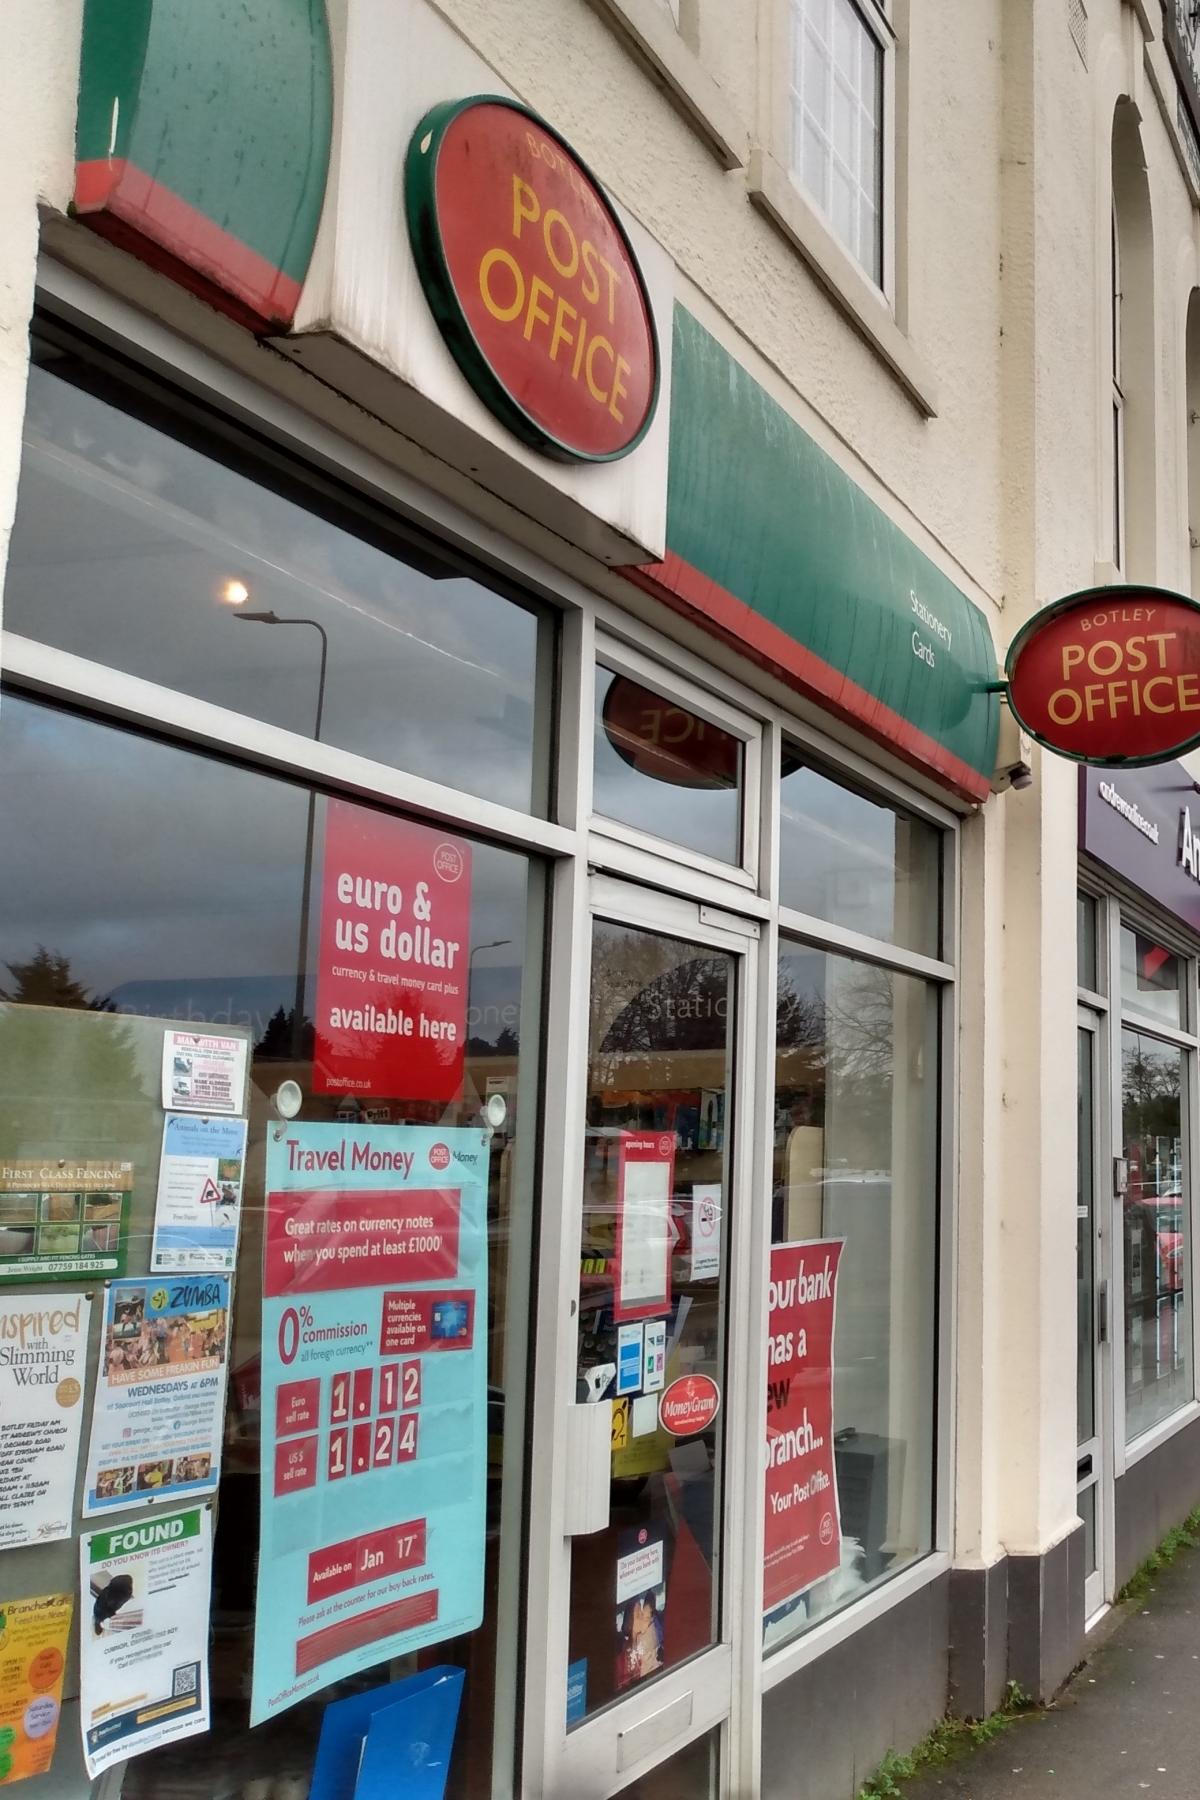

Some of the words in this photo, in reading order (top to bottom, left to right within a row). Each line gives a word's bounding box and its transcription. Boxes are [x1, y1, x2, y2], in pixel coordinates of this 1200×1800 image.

[512, 173, 622, 325] POST
[479, 248, 631, 425] OFFICE
[910, 590, 952, 651] Stationery
[1080, 608, 1156, 631] BOTLEY
[912, 631, 935, 668] Cards
[1062, 633, 1176, 681] POST
[1048, 674, 1200, 725] OFFICE
[437, 861, 459, 874] OFFICE
[441, 851, 457, 863] POST
[337, 873, 402, 915] euro
[413, 881, 432, 922] &
[335, 918, 369, 954] us
[380, 920, 459, 969] dollar
[332, 965, 367, 982] currency
[369, 969, 376, 982] &
[377, 970, 399, 986] travel
[401, 977, 425, 991] money
[427, 980, 442, 992] card
[444, 981, 459, 995] plus
[330, 1004, 413, 1037] available
[420, 1012, 457, 1041] here
[326, 1077, 371, 1090] postoffice.co.uk
[432, 1148, 448, 1157] POST
[625, 1141, 642, 1150] opening
[643, 1141, 655, 1149] hours
[286, 1139, 346, 1172] Travel
[352, 1139, 414, 1180] Money
[430, 1155, 449, 1164] OFFICE
[453, 1150, 478, 1165] Money
[2, 1168, 33, 1179] FIRST
[40, 1168, 73, 1179] CLASS
[76, 1168, 121, 1179] FENCING
[285, 1217, 315, 1235] Great
[317, 1219, 341, 1233] rates
[343, 1221, 357, 1231] on
[359, 1216, 403, 1234] currency
[406, 1215, 433, 1229] notes
[284, 1244, 315, 1263] when
[315, 1247, 336, 1266] you
[338, 1240, 369, 1263] spend
[371, 1243, 381, 1257] at
[383, 1238, 406, 1255] least
[48, 1262, 72, 1270] 07759
[768, 1277, 796, 1312] our
[798, 1255, 833, 1305] bank
[171, 1283, 220, 1308] ZUMBA
[388, 1299, 416, 1313] Multiple
[387, 1313, 422, 1323] currencies
[302, 1321, 368, 1343] commission
[386, 1323, 416, 1336] available
[417, 1325, 426, 1333] on
[27, 1338, 48, 1350] with
[386, 1338, 399, 1347] one
[400, 1335, 415, 1346] card
[797, 1328, 807, 1358] a
[0, 1346, 75, 1366] Slimming
[301, 1351, 309, 1362] all
[310, 1348, 334, 1363] foreign
[13, 1365, 58, 1386] World
[111, 1370, 135, 1384] HAVE
[138, 1367, 163, 1380] SOME
[201, 1359, 219, 1371] FUN
[128, 1380, 188, 1397] WEDNESDAYS
[200, 1378, 218, 1388] 6PM
[766, 1378, 790, 1414] ew
[291, 1397, 305, 1408] Euro
[664, 1396, 716, 1418] MoneyGram
[285, 1413, 297, 1424] sell
[297, 1410, 309, 1422] rate
[289, 1453, 298, 1463] US
[298, 1451, 304, 1462] $
[283, 1470, 294, 1481] sell
[295, 1467, 307, 1478] rate
[770, 1492, 792, 1515] Your
[794, 1482, 810, 1503] Post
[109, 1519, 184, 1554] FOUND
[113, 1559, 128, 1567] YOU
[129, 1553, 149, 1562] KNOW
[312, 1563, 343, 1584] Available
[343, 1561, 352, 1571] on
[360, 1549, 384, 1571] Jan
[298, 1611, 315, 1628] Please
[316, 1606, 325, 1620] ask
[326, 1605, 333, 1616] at
[333, 1602, 343, 1613] the
[343, 1594, 367, 1609] counter
[367, 1588, 376, 1600] for
[377, 1587, 388, 1596] our
[389, 1582, 401, 1596] buy
[402, 1577, 417, 1589] back
[418, 1572, 435, 1585] rates.
